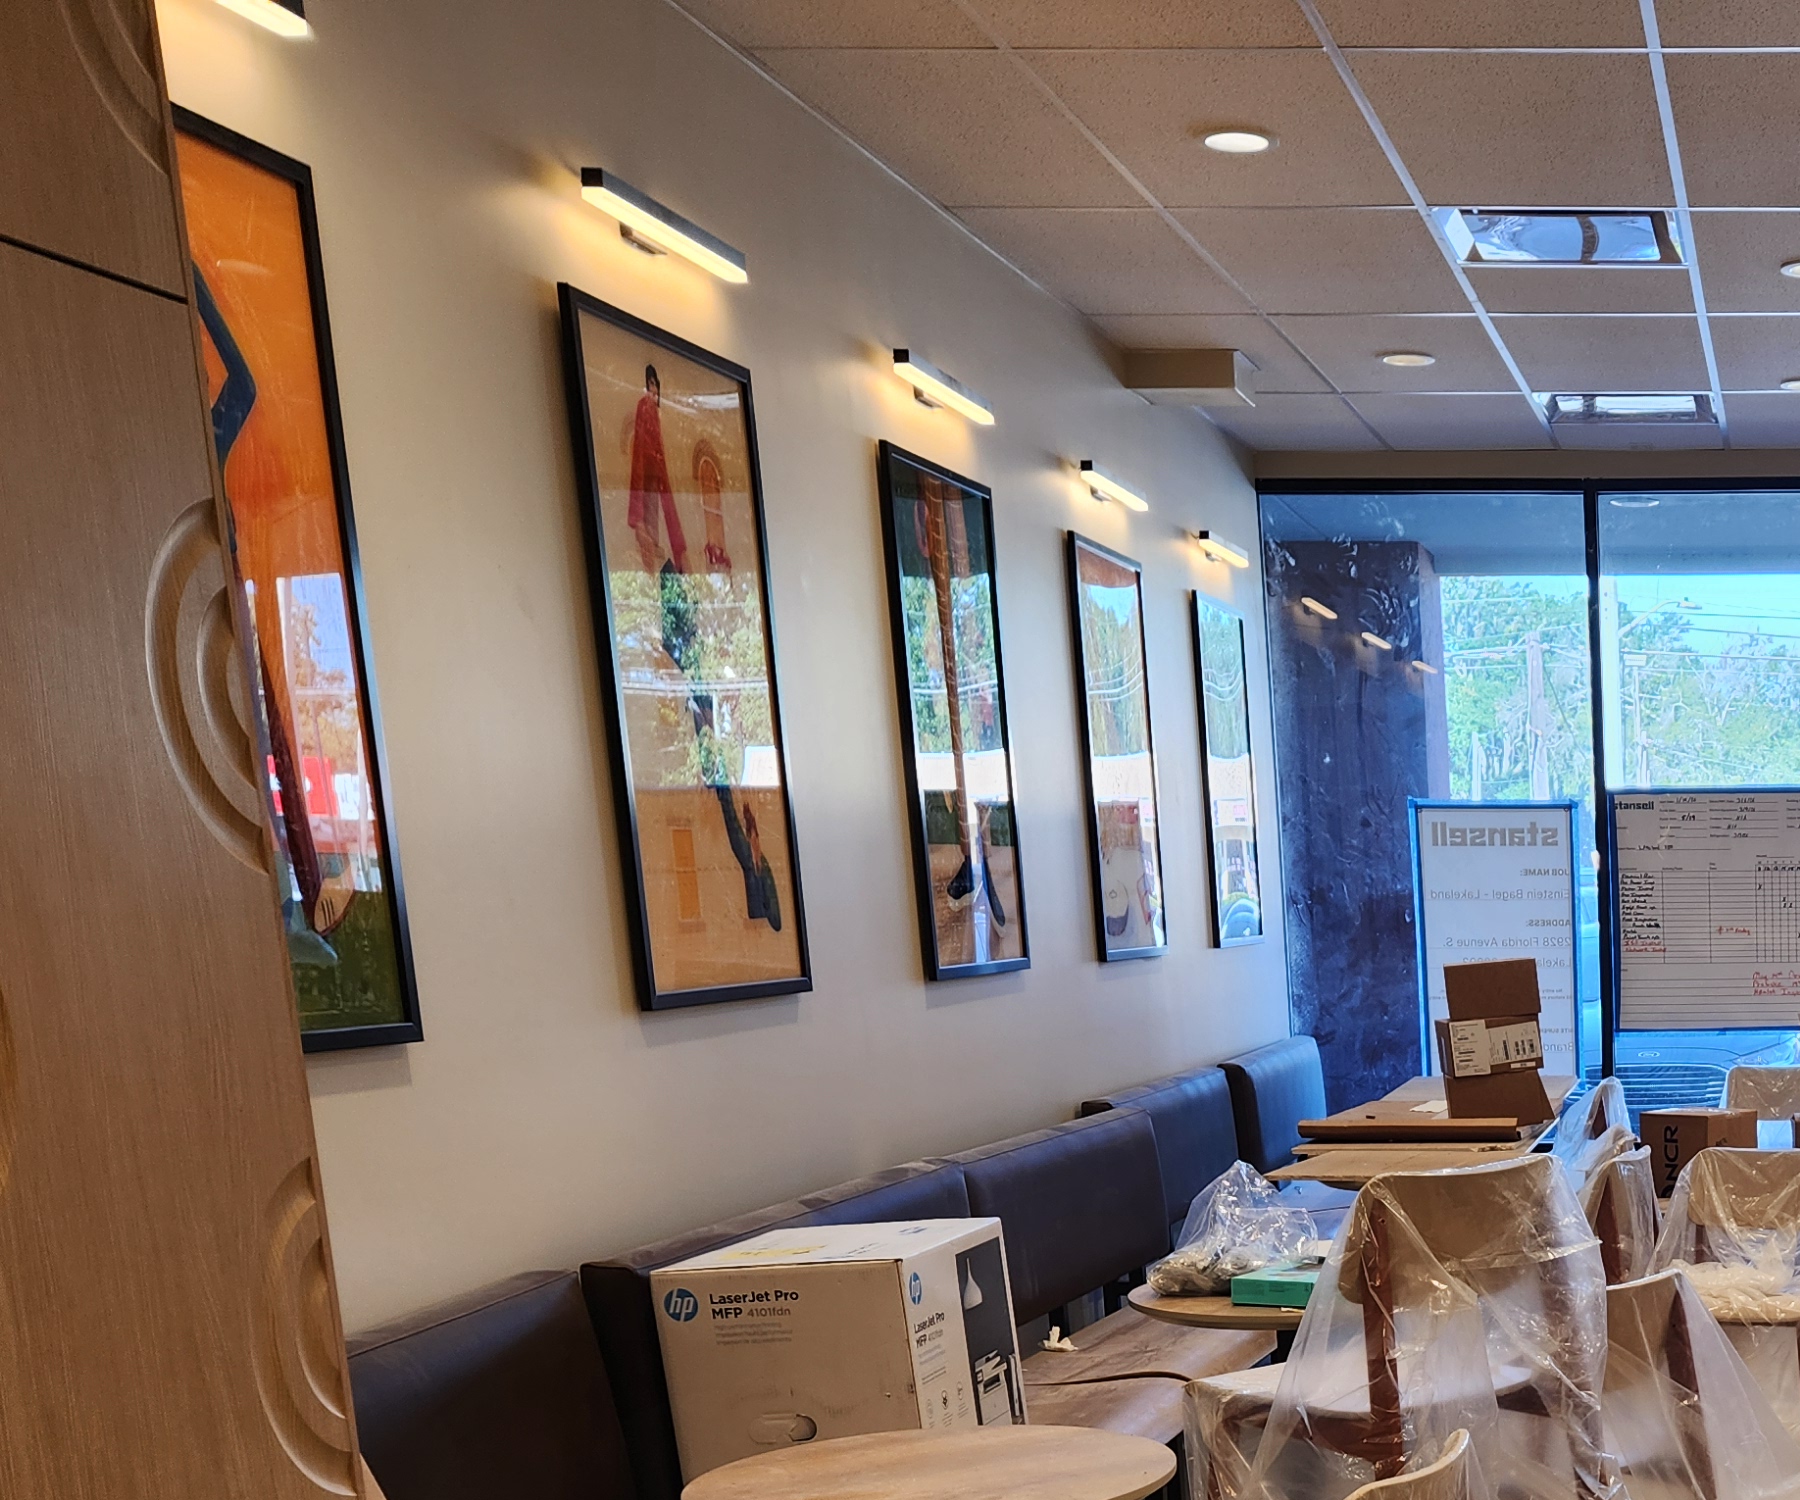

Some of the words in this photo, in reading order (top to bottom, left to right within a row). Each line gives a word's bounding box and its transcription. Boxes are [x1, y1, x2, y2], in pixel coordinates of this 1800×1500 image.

[668, 1288, 696, 1322] hp
[709, 1290, 771, 1305] LaserJet
[774, 1289, 799, 1301] Pro
[711, 1307, 743, 1320] MFP
[747, 1307, 791, 1318] 4101fdn
[914, 1316, 935, 1334] LaserJet
[935, 1311, 945, 1323] Pro
